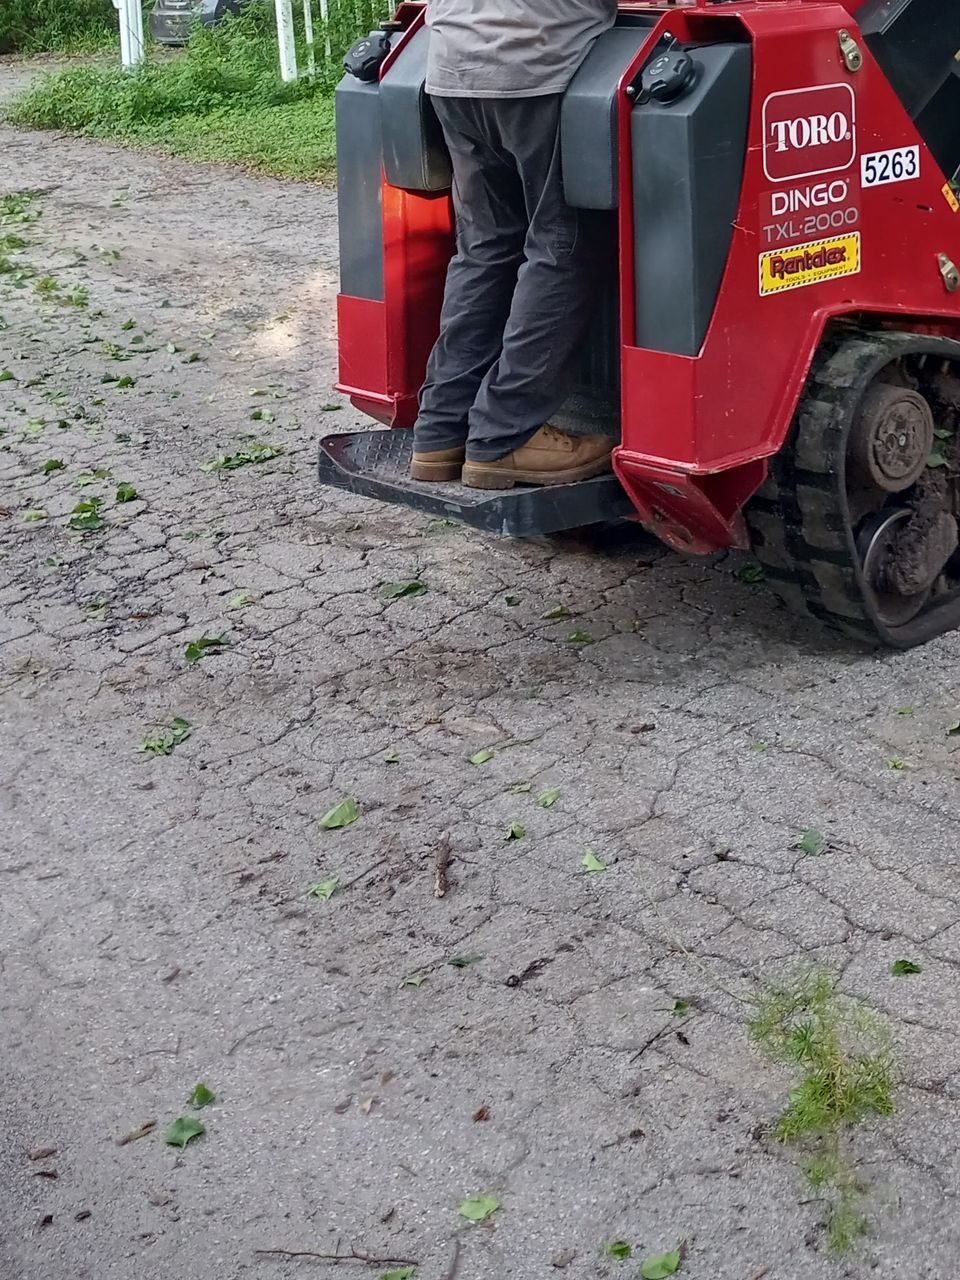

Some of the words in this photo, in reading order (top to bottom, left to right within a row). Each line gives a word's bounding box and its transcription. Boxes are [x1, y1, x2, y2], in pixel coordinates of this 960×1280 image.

[771, 112, 848, 153] TORO
[865, 149, 916, 184] 5263
[771, 180, 848, 217] DINGO
[769, 245, 846, 280] Rentalex
[785, 274, 806, 284] TOOLS
[813, 265, 846, 277] EQUIPMENT
